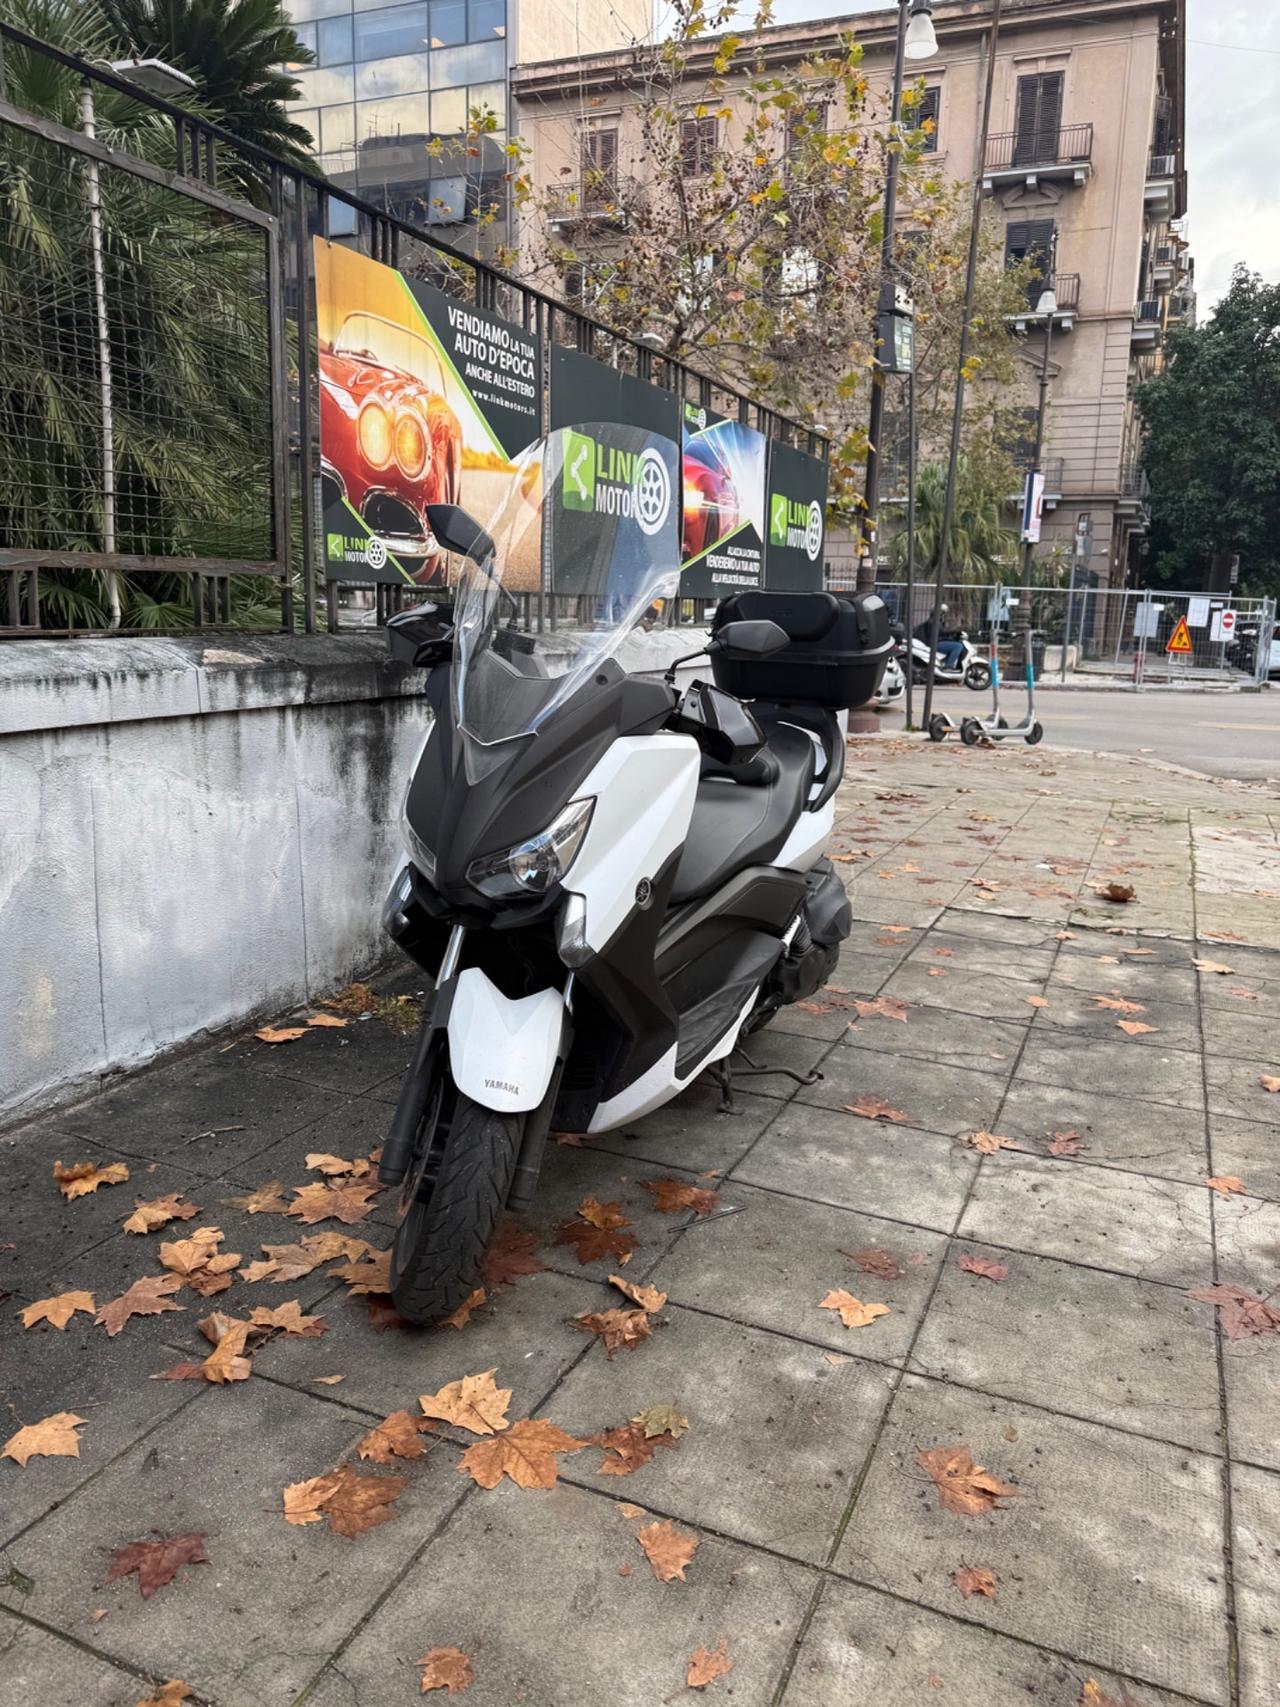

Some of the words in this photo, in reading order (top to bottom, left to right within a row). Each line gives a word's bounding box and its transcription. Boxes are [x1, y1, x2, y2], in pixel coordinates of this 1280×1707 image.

[448, 306, 509, 348] VENDIAMO
[510, 338, 520, 353] LA
[520, 343, 535, 360] TUA
[455, 333, 486, 361] AUTO
[488, 346, 535, 380] D'EPOCA
[465, 362, 493, 384] ANCHE
[493, 373, 535, 398] ALL'ESTERO
[472, 389, 536, 416] www.linkmotors.it
[485, 1080, 519, 1096] YAMAHA
